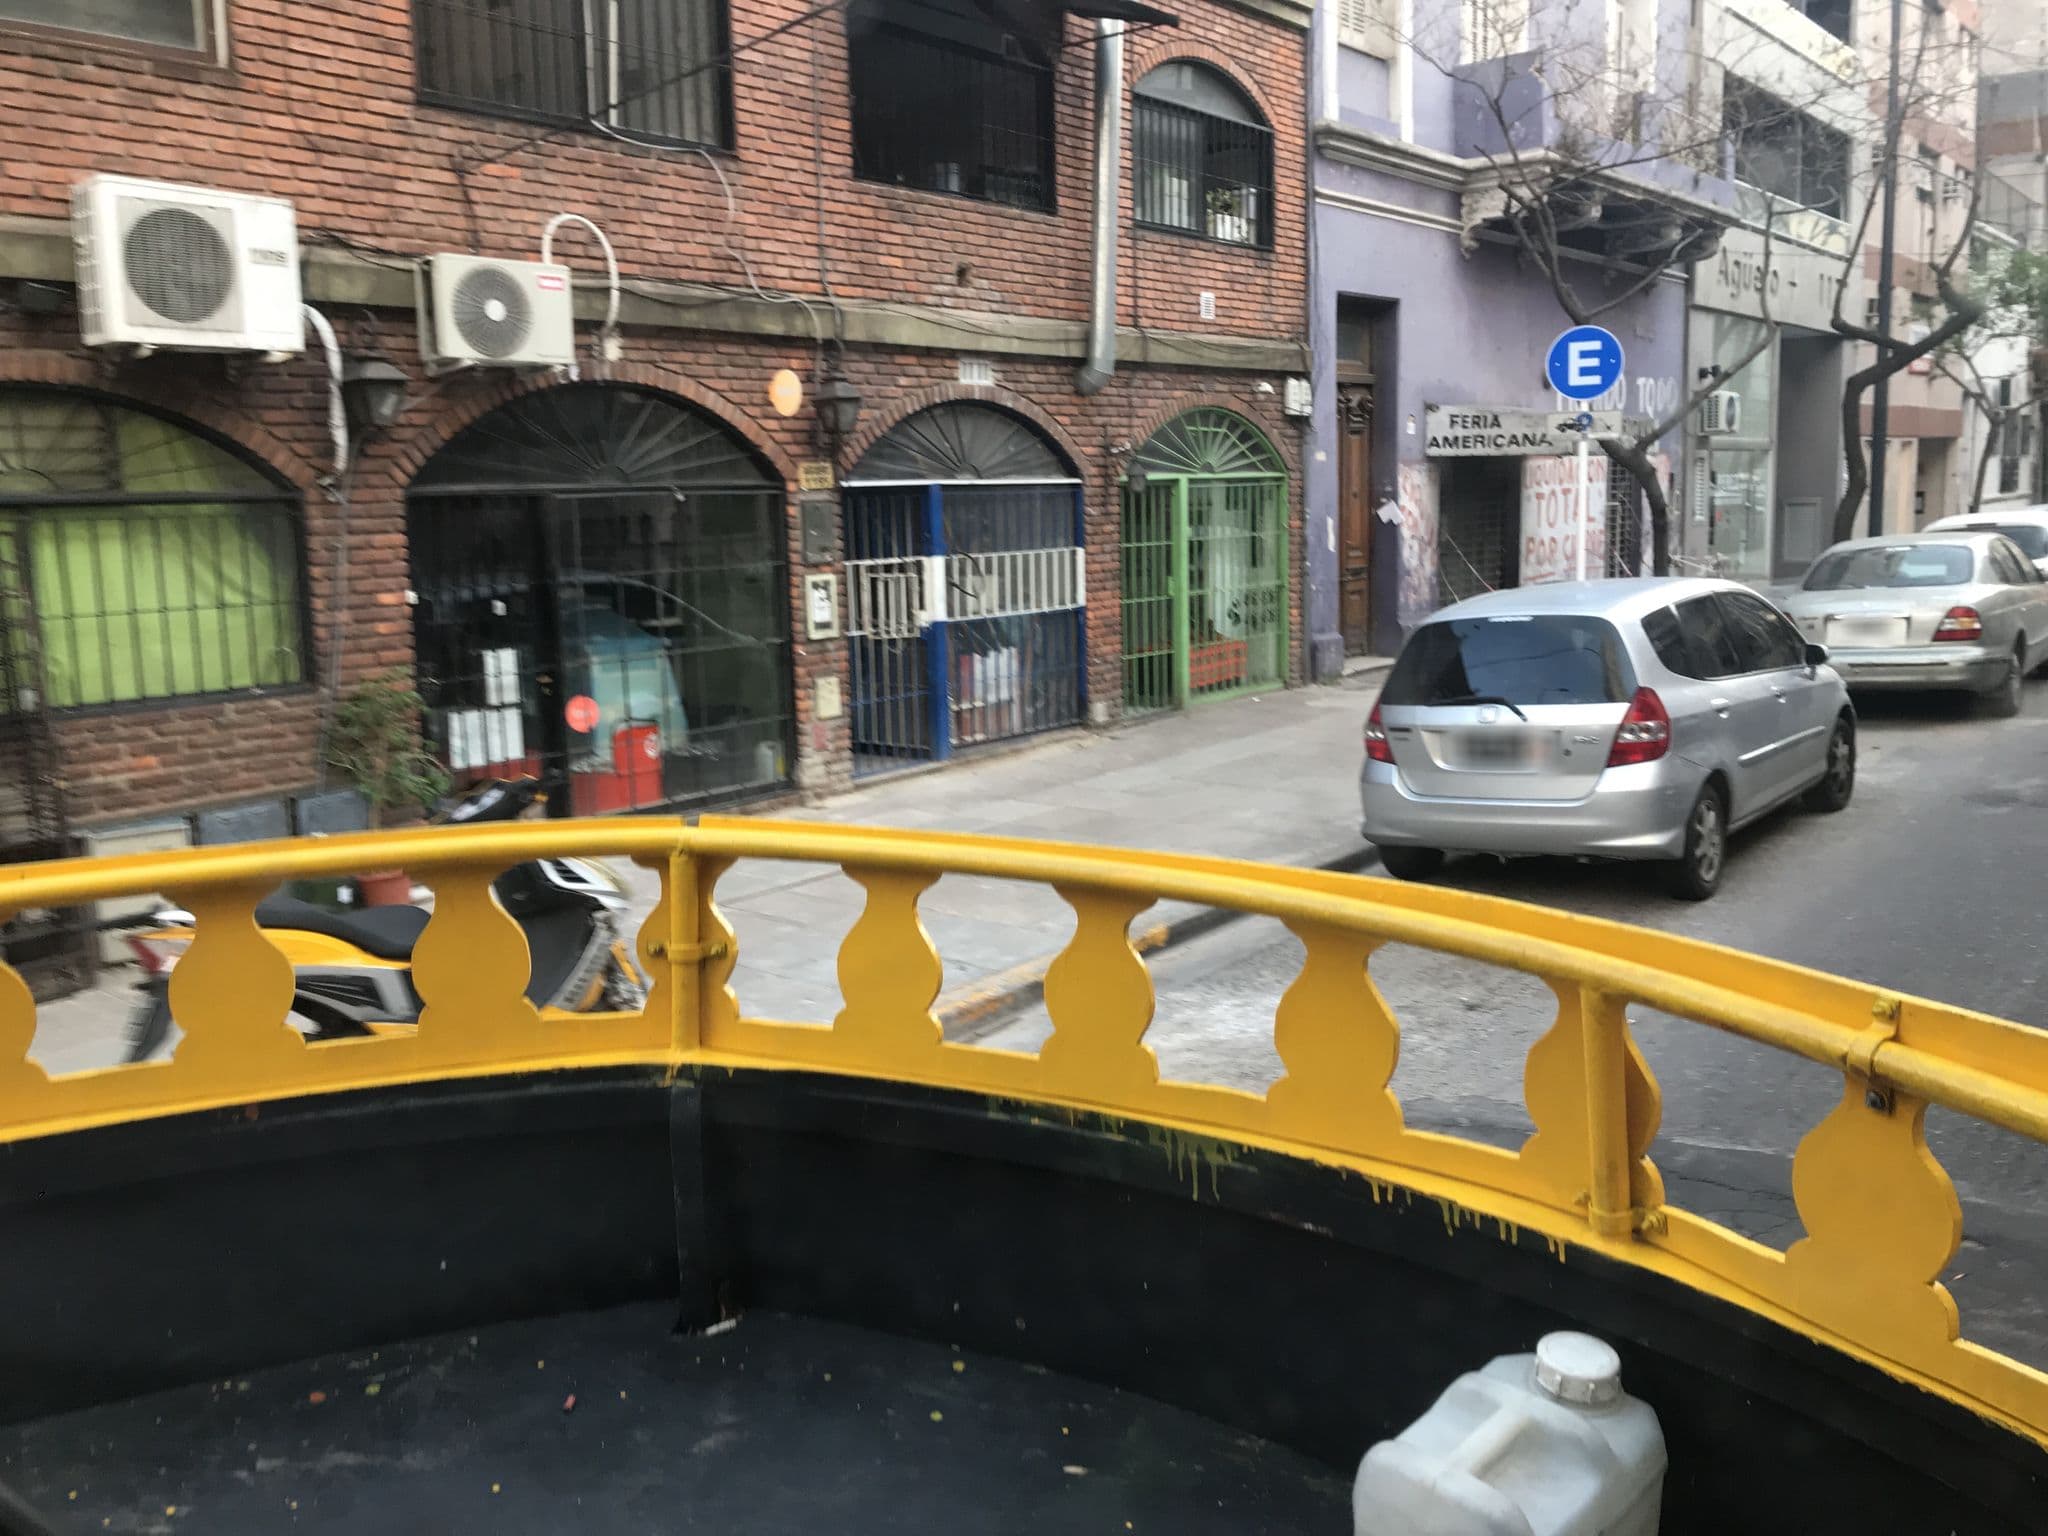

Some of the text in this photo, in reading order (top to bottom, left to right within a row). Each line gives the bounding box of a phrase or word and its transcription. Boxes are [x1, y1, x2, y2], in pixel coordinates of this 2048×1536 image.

[1717, 246, 1779, 298] Agüeo
[1568, 341, 1602, 387] E
[1449, 414, 1502, 429] FERIA
[1428, 432, 1553, 449] AMERICANA
